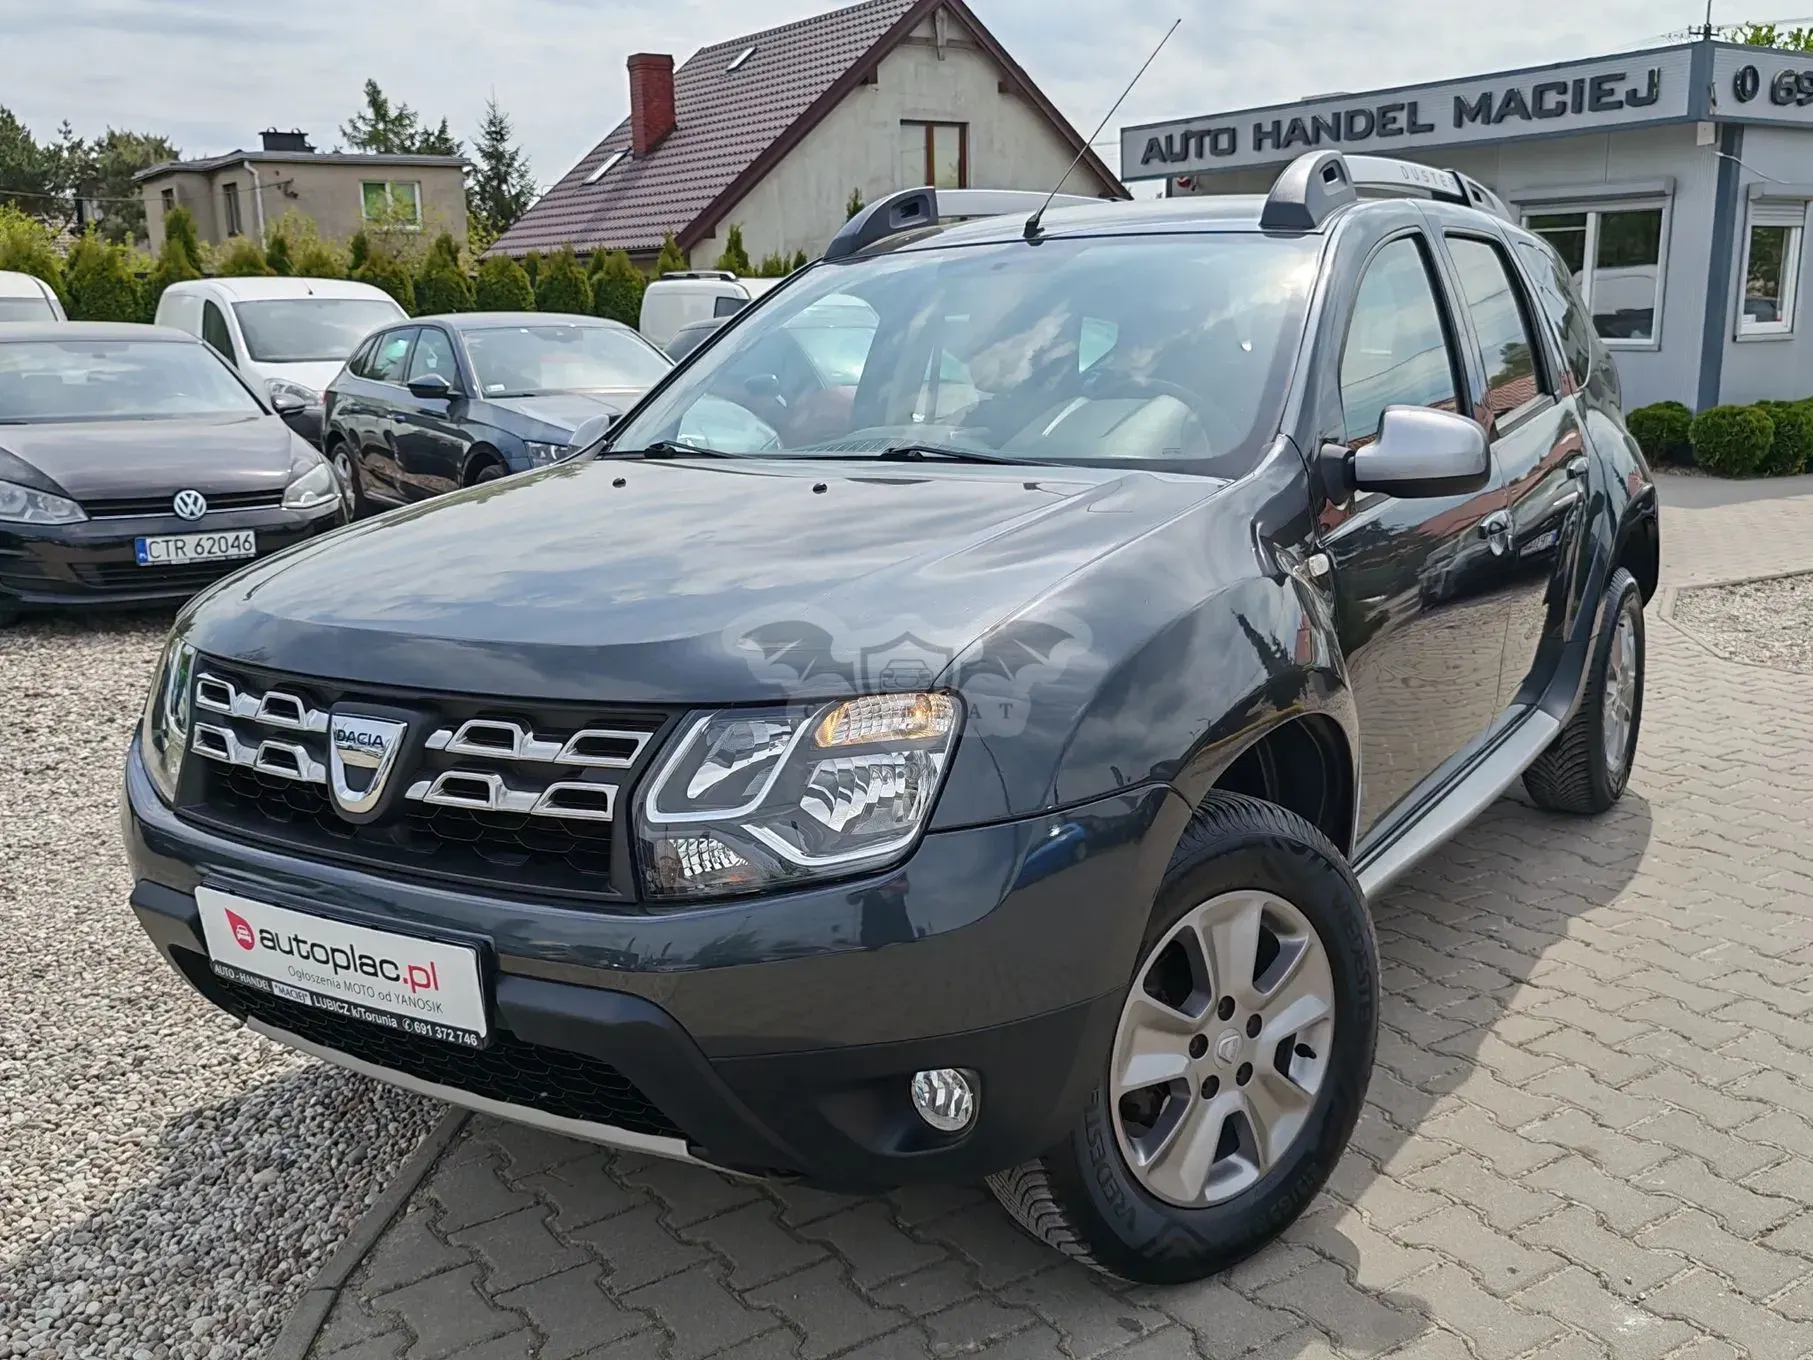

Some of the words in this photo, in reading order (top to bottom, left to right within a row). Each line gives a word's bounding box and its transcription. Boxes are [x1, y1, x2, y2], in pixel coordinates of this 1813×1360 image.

[1140, 127, 1237, 165] AUTO
[1253, 101, 1435, 152] HANDEL
[1453, 67, 1661, 128] MACIEJ
[149, 538, 187, 559] CTR
[194, 534, 253, 556] 62046
[336, 729, 384, 749] DACIA
[259, 929, 439, 994] autoplac.pl
[343, 981, 375, 999] MOTO
[378, 991, 392, 1003] od
[394, 994, 444, 1014] YANOSIK
[313, 995, 350, 1015] LUBICZ
[414, 1022, 433, 1036] 691
[435, 1026, 455, 1041] 372
[457, 1031, 478, 1046] 746
